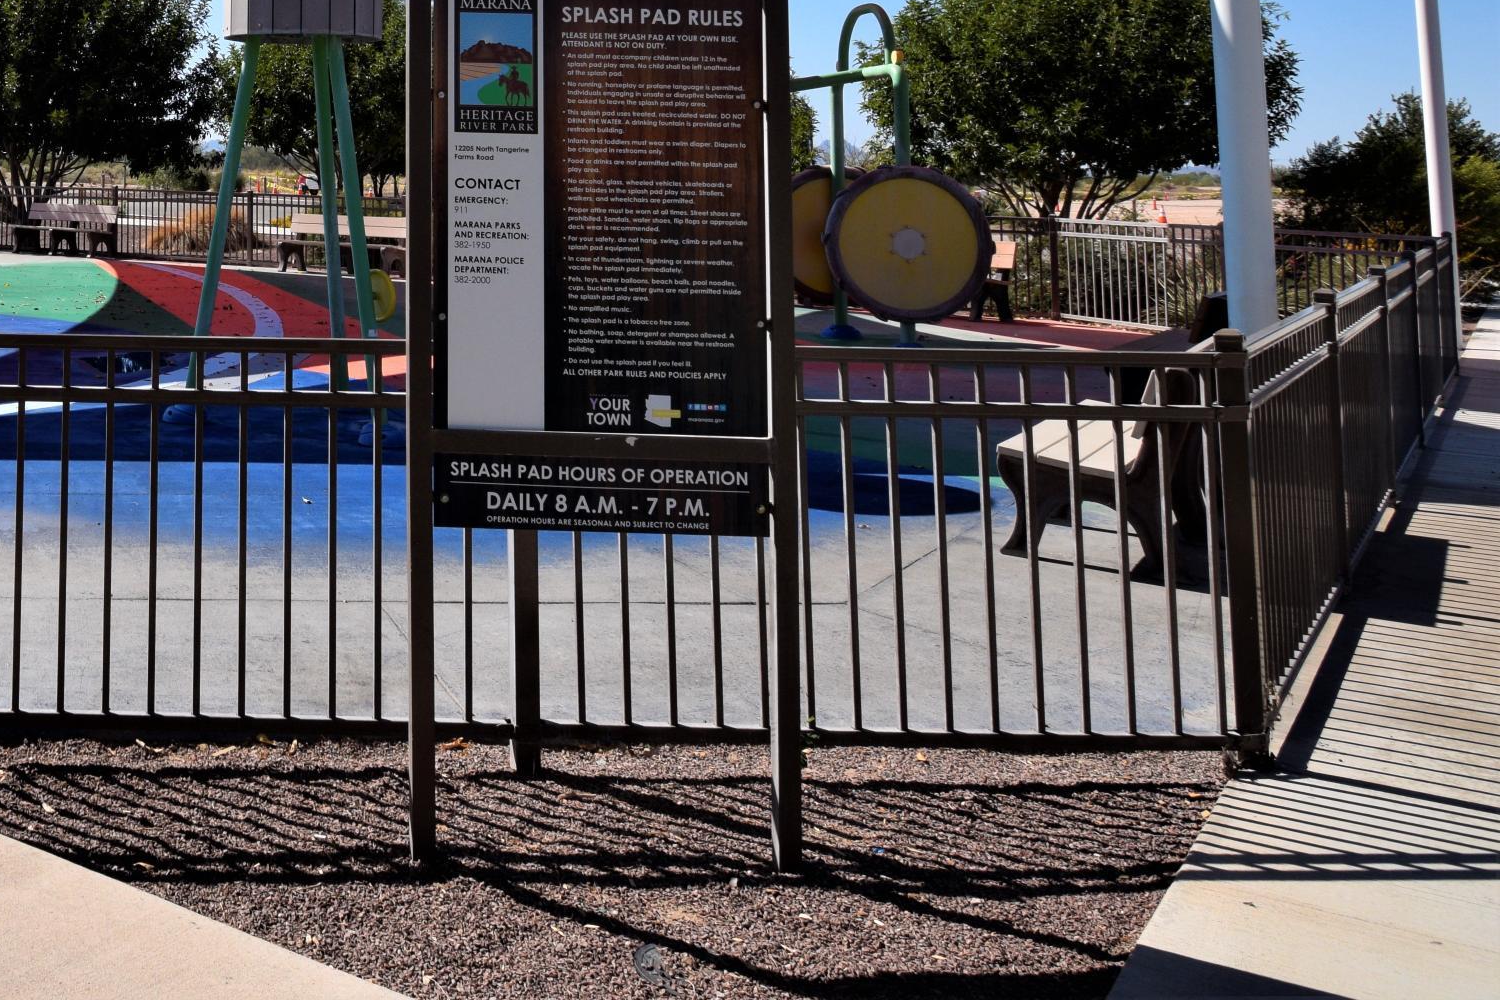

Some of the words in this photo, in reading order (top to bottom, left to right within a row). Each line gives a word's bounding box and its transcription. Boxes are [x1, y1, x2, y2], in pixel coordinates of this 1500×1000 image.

[562, 6, 633, 24] SPLASH
[640, 8, 680, 25] PAD
[688, 10, 743, 27] RULES
[562, 32, 587, 40] PLEASE
[588, 32, 602, 40] USE
[618, 33, 646, 41] SPLASH
[665, 34, 675, 42] AT
[676, 34, 698, 42] YOUR
[720, 35, 738, 43] RISK.
[562, 40, 604, 48] ATTENDANT
[613, 41, 630, 49] NOT
[645, 42, 667, 50] DUTY.
[460, 109, 534, 121] HERITAGE
[460, 121, 496, 130] RIVER
[502, 123, 534, 131] PARK
[495, 146, 530, 154] Tangerine
[454, 177, 521, 190] CONTACT
[454, 196, 508, 205] EMERGENCY:
[454, 206, 468, 214] 911
[454, 221, 492, 229] MARANA
[495, 222, 521, 230] PARKS
[454, 231, 473, 239] AND
[475, 232, 530, 240] RECREATION:
[454, 241, 491, 249] 382-1950
[454, 256, 492, 264] MARANA
[495, 257, 525, 265] POLICE
[454, 266, 509, 275] DEPARTMENT:
[454, 276, 491, 284] 382-2000
[563, 368, 576, 376] ALL
[577, 369, 602, 377] OTHER
[603, 369, 624, 377] PARK
[625, 370, 647, 378] RULES
[648, 370, 666, 378] AND
[667, 371, 701, 379] POLICIES
[702, 372, 726, 380] APPLY
[590, 398, 630, 411] YOUR
[586, 412, 632, 426] TOWN
[450, 462, 511, 478] SPLASH
[518, 464, 552, 480] PAD
[559, 466, 616, 482] HOURS
[622, 468, 645, 483] OF
[650, 469, 748, 486] OPERATION
[486, 491, 548, 511] DAILY
[555, 494, 568, 513] 8
[575, 495, 623, 514] A.M.
[647, 498, 658, 515] 7
[666, 498, 710, 516] P.M.
[487, 515, 529, 524] OPERATION
[574, 519, 612, 527] SEASONAL
